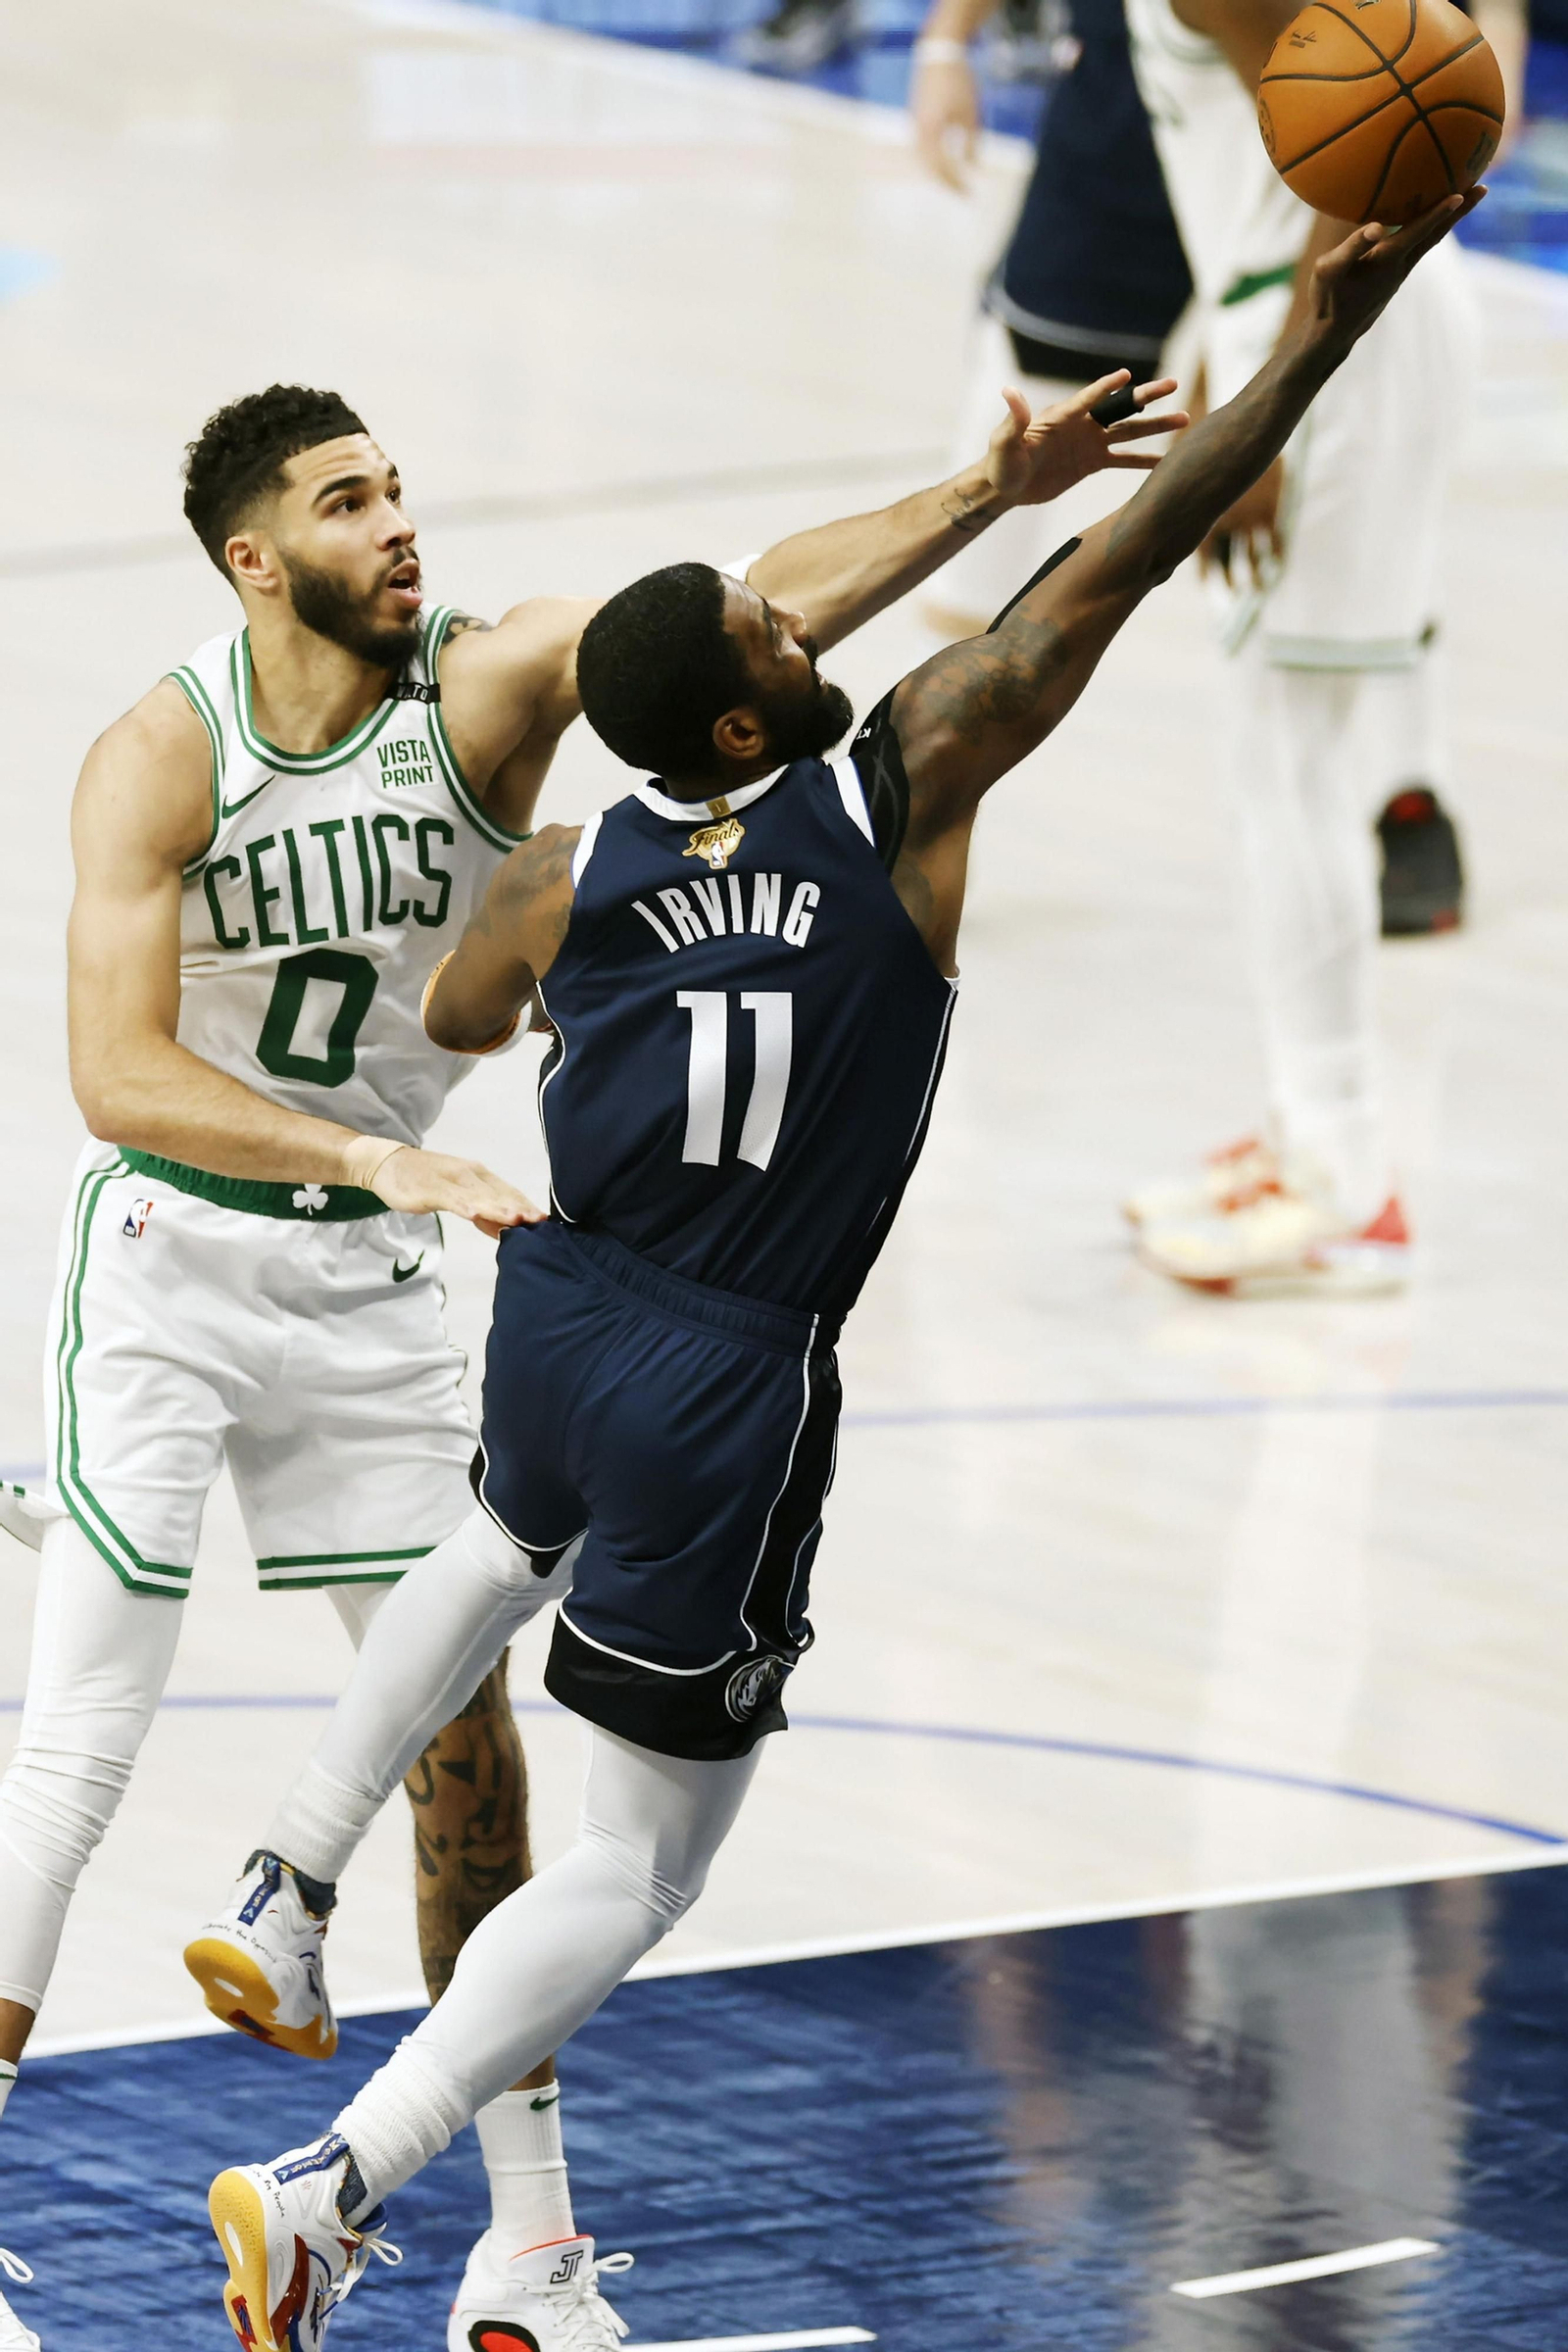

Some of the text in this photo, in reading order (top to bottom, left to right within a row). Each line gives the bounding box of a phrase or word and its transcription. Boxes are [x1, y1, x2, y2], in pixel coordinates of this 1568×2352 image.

[377, 740, 431, 767] VISTA
[381, 765, 432, 788] PRINT
[685, 820, 739, 856] Finals
[204, 814, 454, 949] CELTICS
[631, 873, 820, 954] IRVING
[256, 948, 379, 1088] 0
[676, 991, 793, 1172] 11
[550, 2249, 584, 2284] JT
